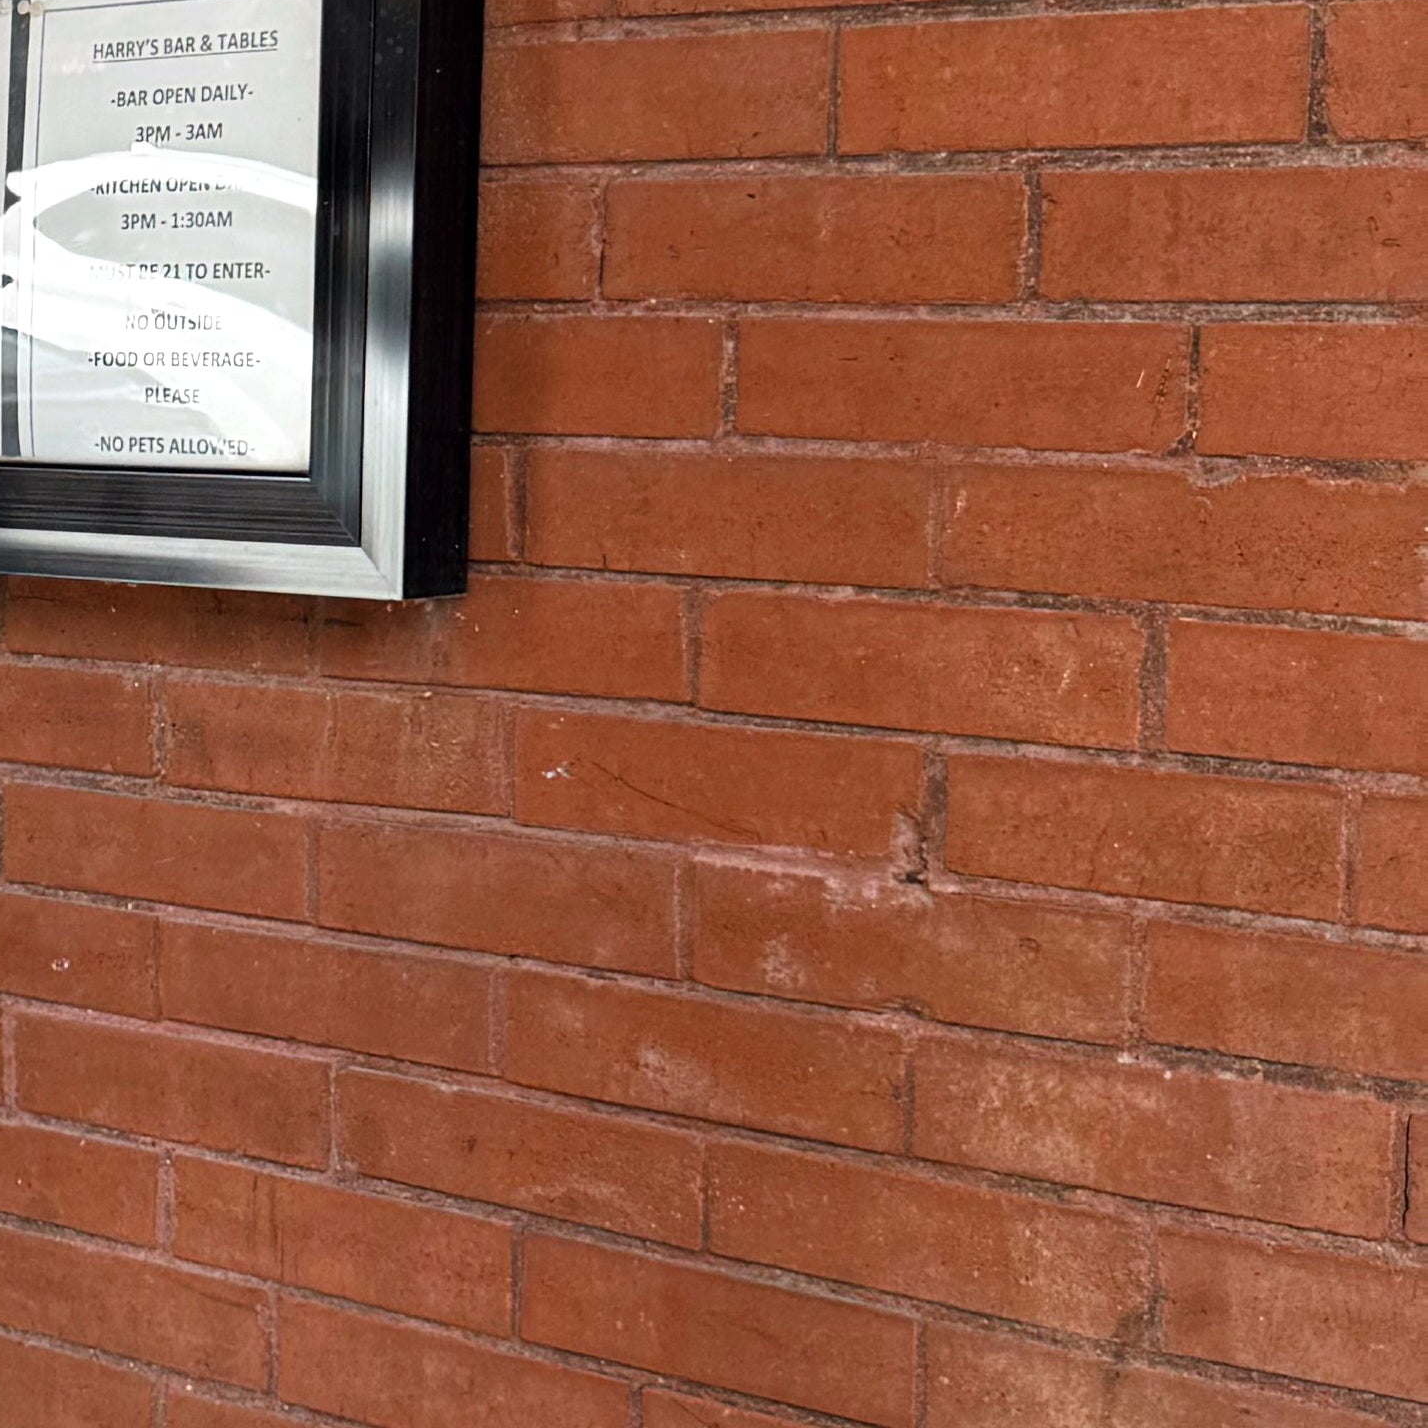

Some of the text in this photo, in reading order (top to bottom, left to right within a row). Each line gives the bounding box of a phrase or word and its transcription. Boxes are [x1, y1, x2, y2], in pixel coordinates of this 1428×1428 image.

[93, 30, 278, 60] HARRY'S BAR & TABLES
[111, 83, 254, 108] -BAR OPEN DAILY-
[135, 126, 171, 143] 3PM
[185, 123, 223, 141] 3AM
[121, 213, 156, 230] 3PM
[171, 210, 233, 229] 1:30AM
[163, 262, 181, 280] 21
[185, 262, 208, 280] TO
[213, 261, 271, 280] ENTER-
[125, 313, 224, 332] NO OUTSIDE
[88, 351, 261, 368] -FOOD OR BEVERAGE-
[144, 386, 201, 404] PLEASE
[94, 435, 124, 453] -NO
[128, 436, 165, 454] PETS
